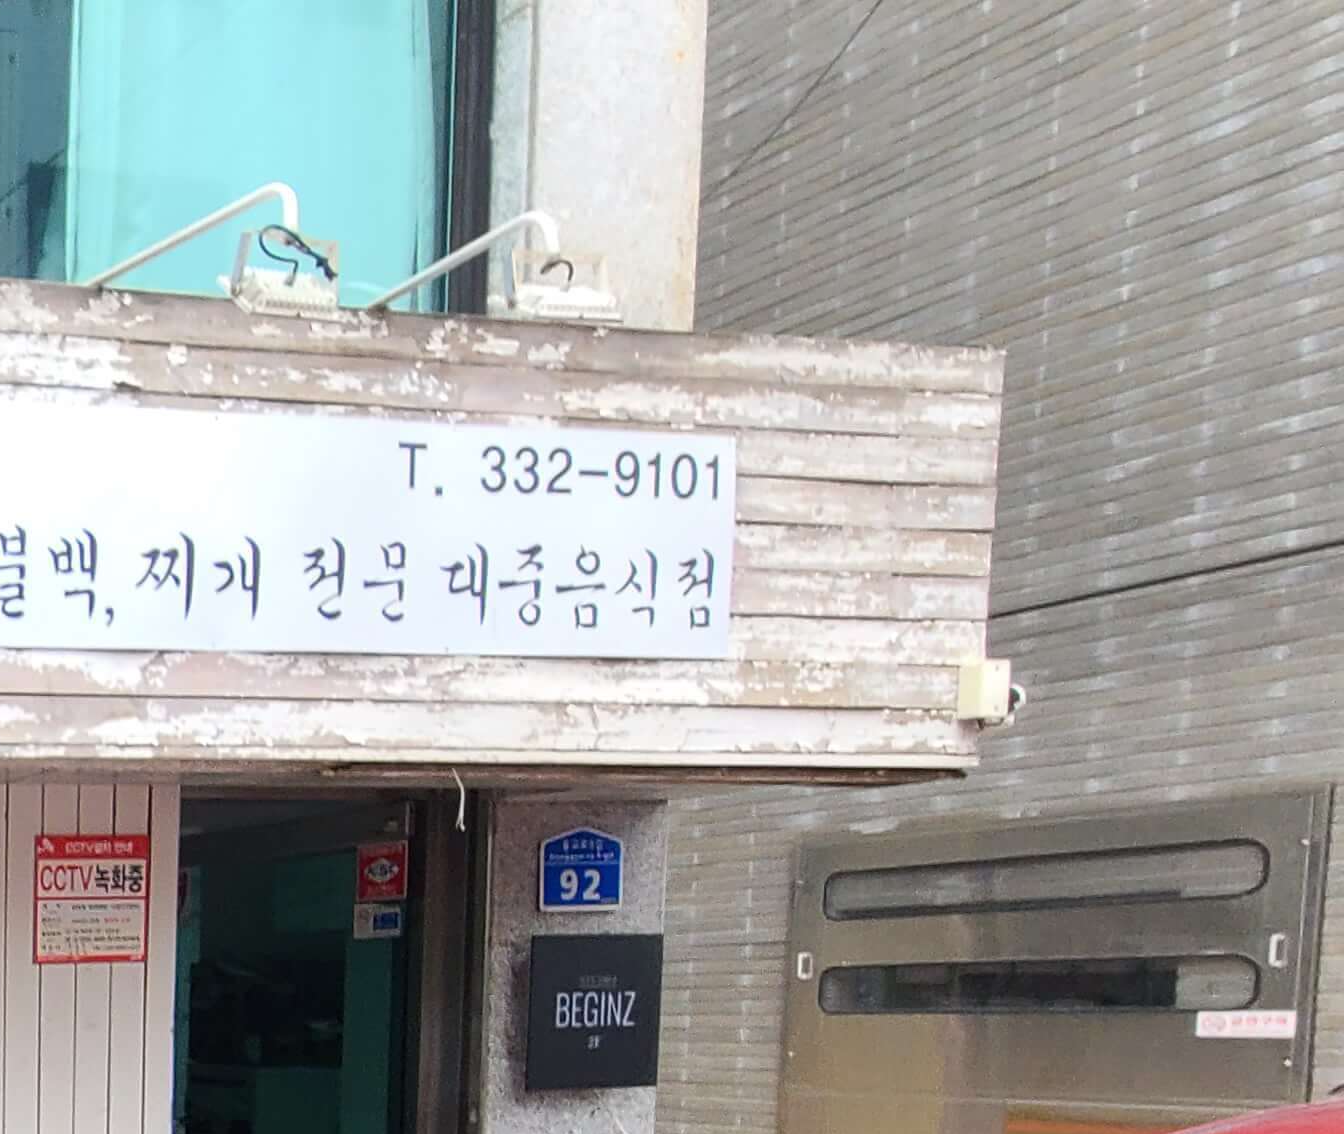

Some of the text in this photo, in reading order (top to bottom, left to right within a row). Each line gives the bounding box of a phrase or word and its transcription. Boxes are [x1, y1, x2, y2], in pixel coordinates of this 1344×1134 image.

[398, 442, 724, 500] T. 332-9101
[136, 531, 261, 622] 찌개
[303, 537, 408, 622] 전문
[441, 541, 715, 631] 대중음식점
[41, 864, 143, 893] CCTV녹화중
[560, 869, 601, 900] 92
[555, 991, 637, 1029] BEGINZ
